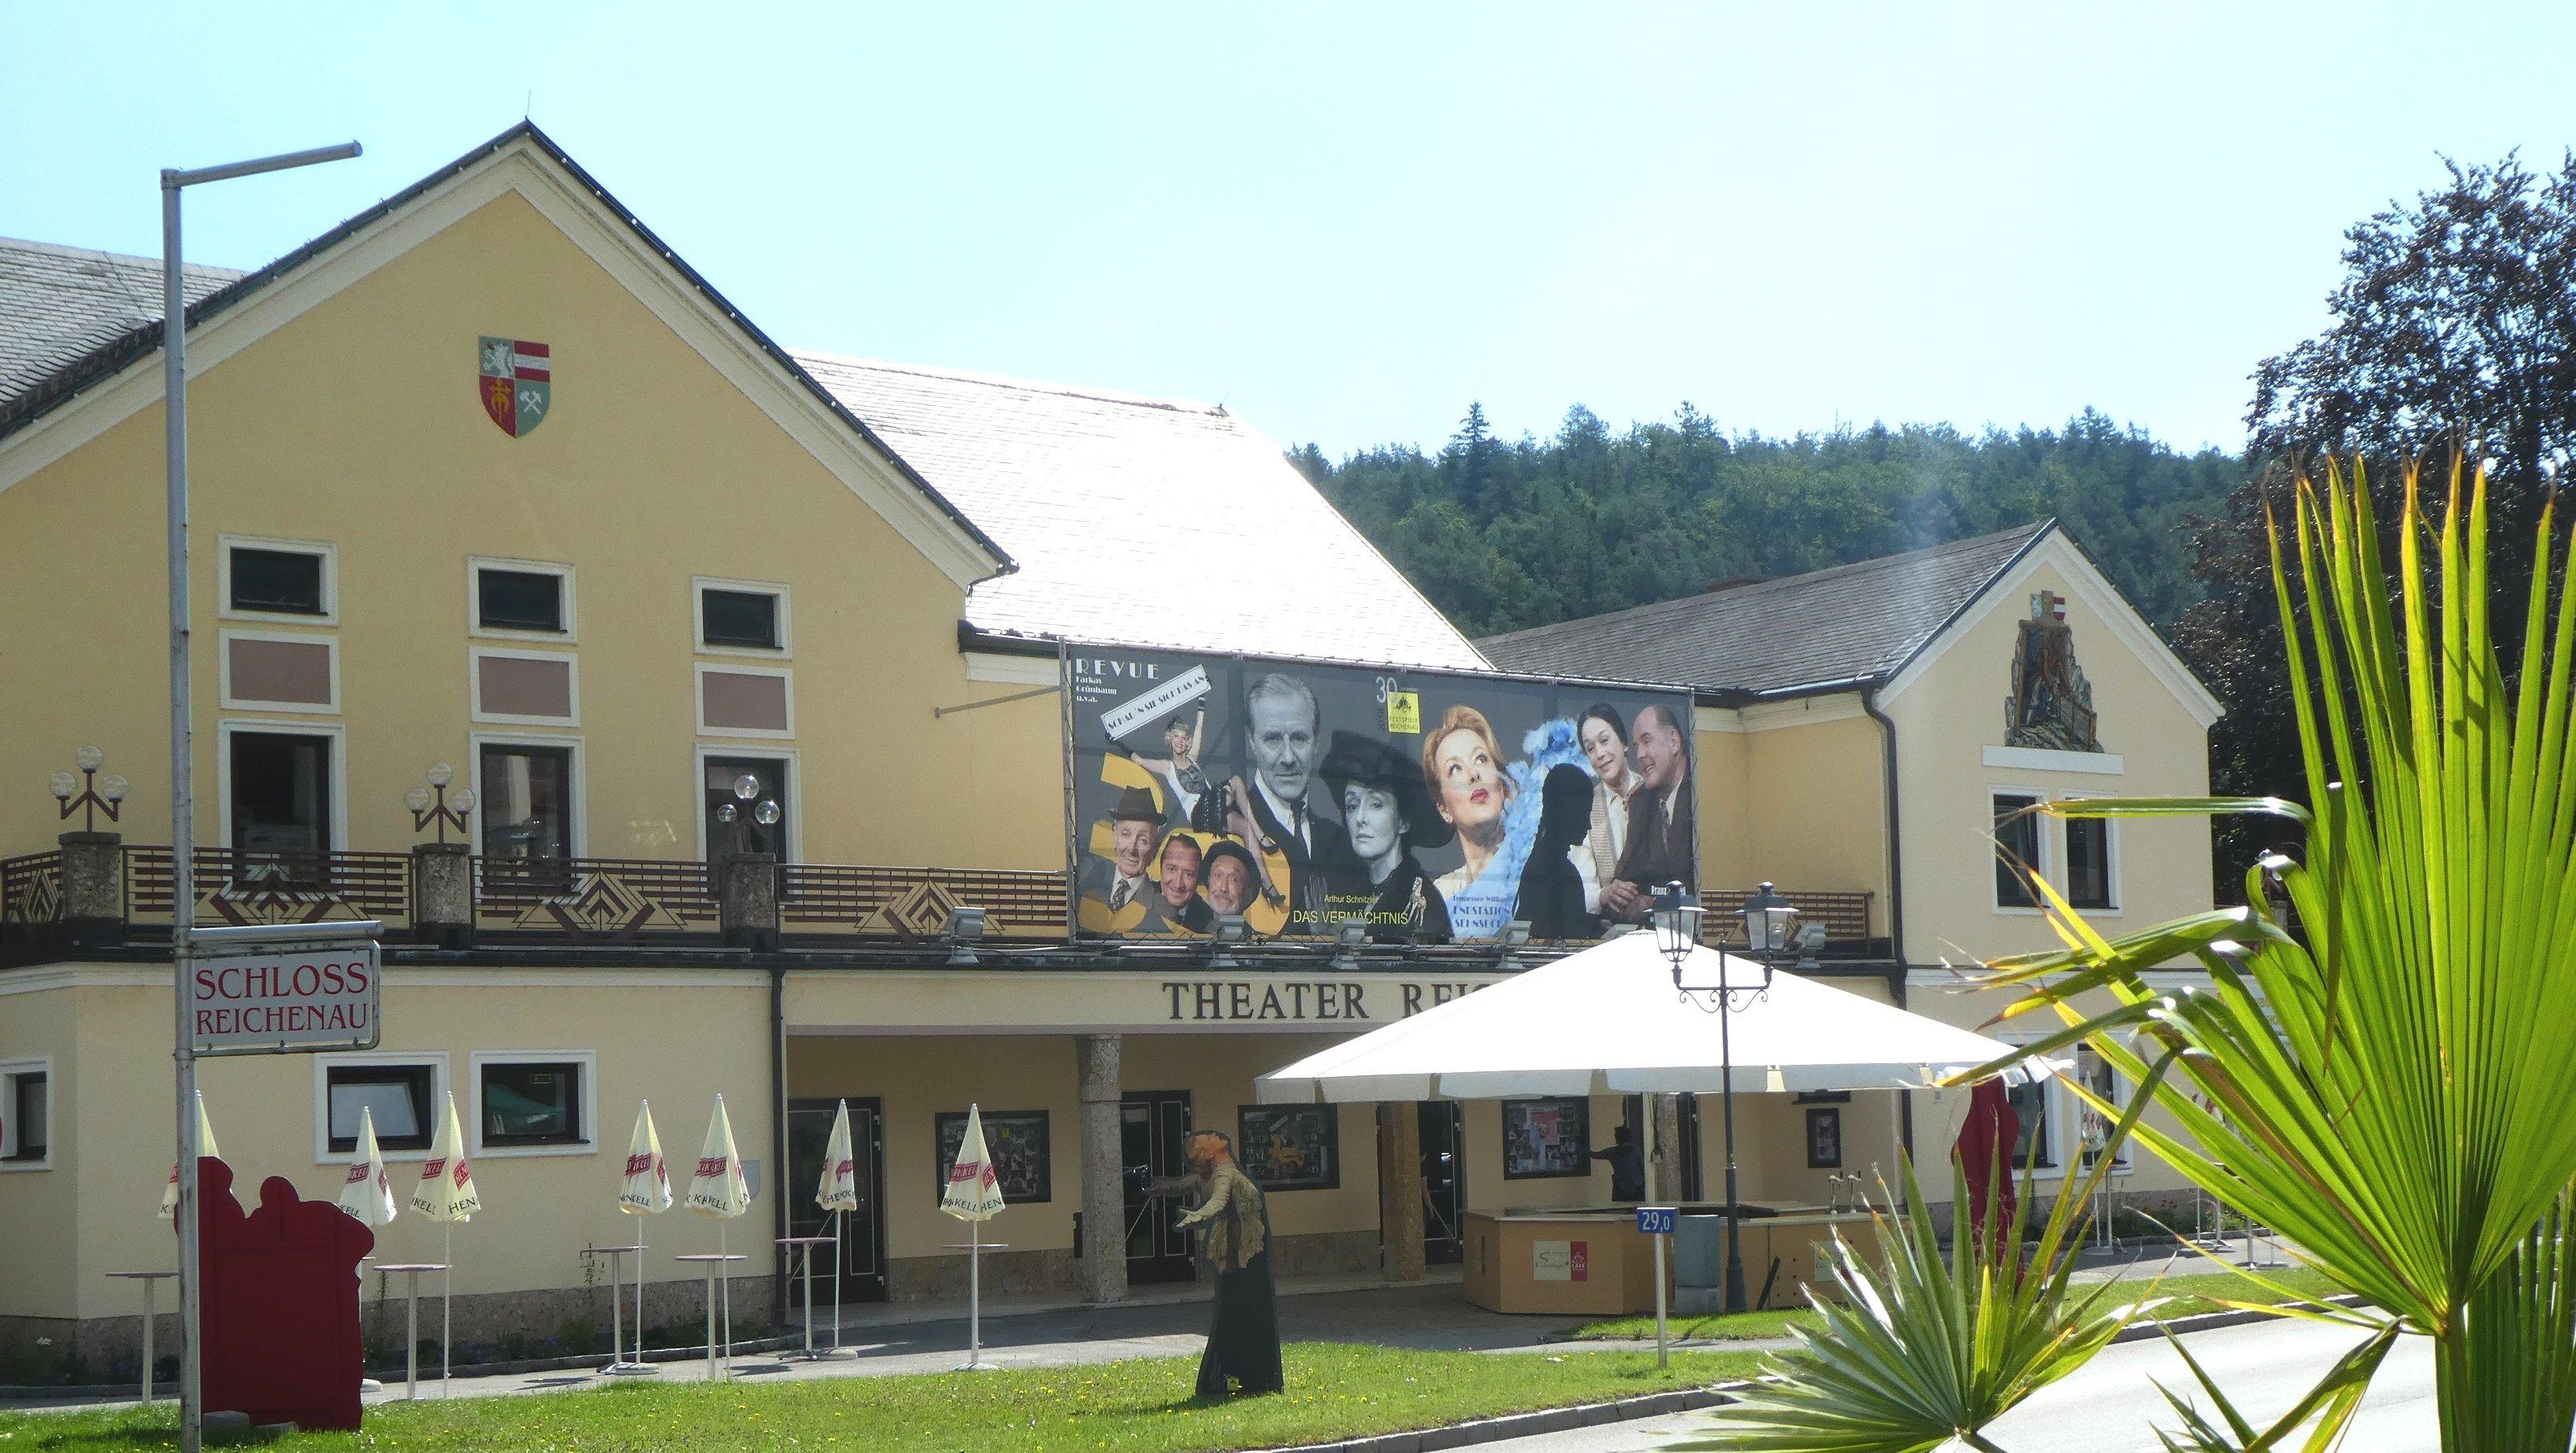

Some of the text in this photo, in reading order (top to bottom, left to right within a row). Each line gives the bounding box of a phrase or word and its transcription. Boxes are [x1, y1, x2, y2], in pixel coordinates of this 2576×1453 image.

[1076, 658, 1160, 679] REVUE
[1325, 894, 1378, 904] Arthur Schnitzler
[1293, 910, 1318, 923] DAS
[195, 962, 368, 1000] SCHLOSS
[1162, 982, 1370, 1020] THEATER
[196, 1003, 367, 1035] REICHENAU
[1642, 1211, 1670, 1233] 29,0
